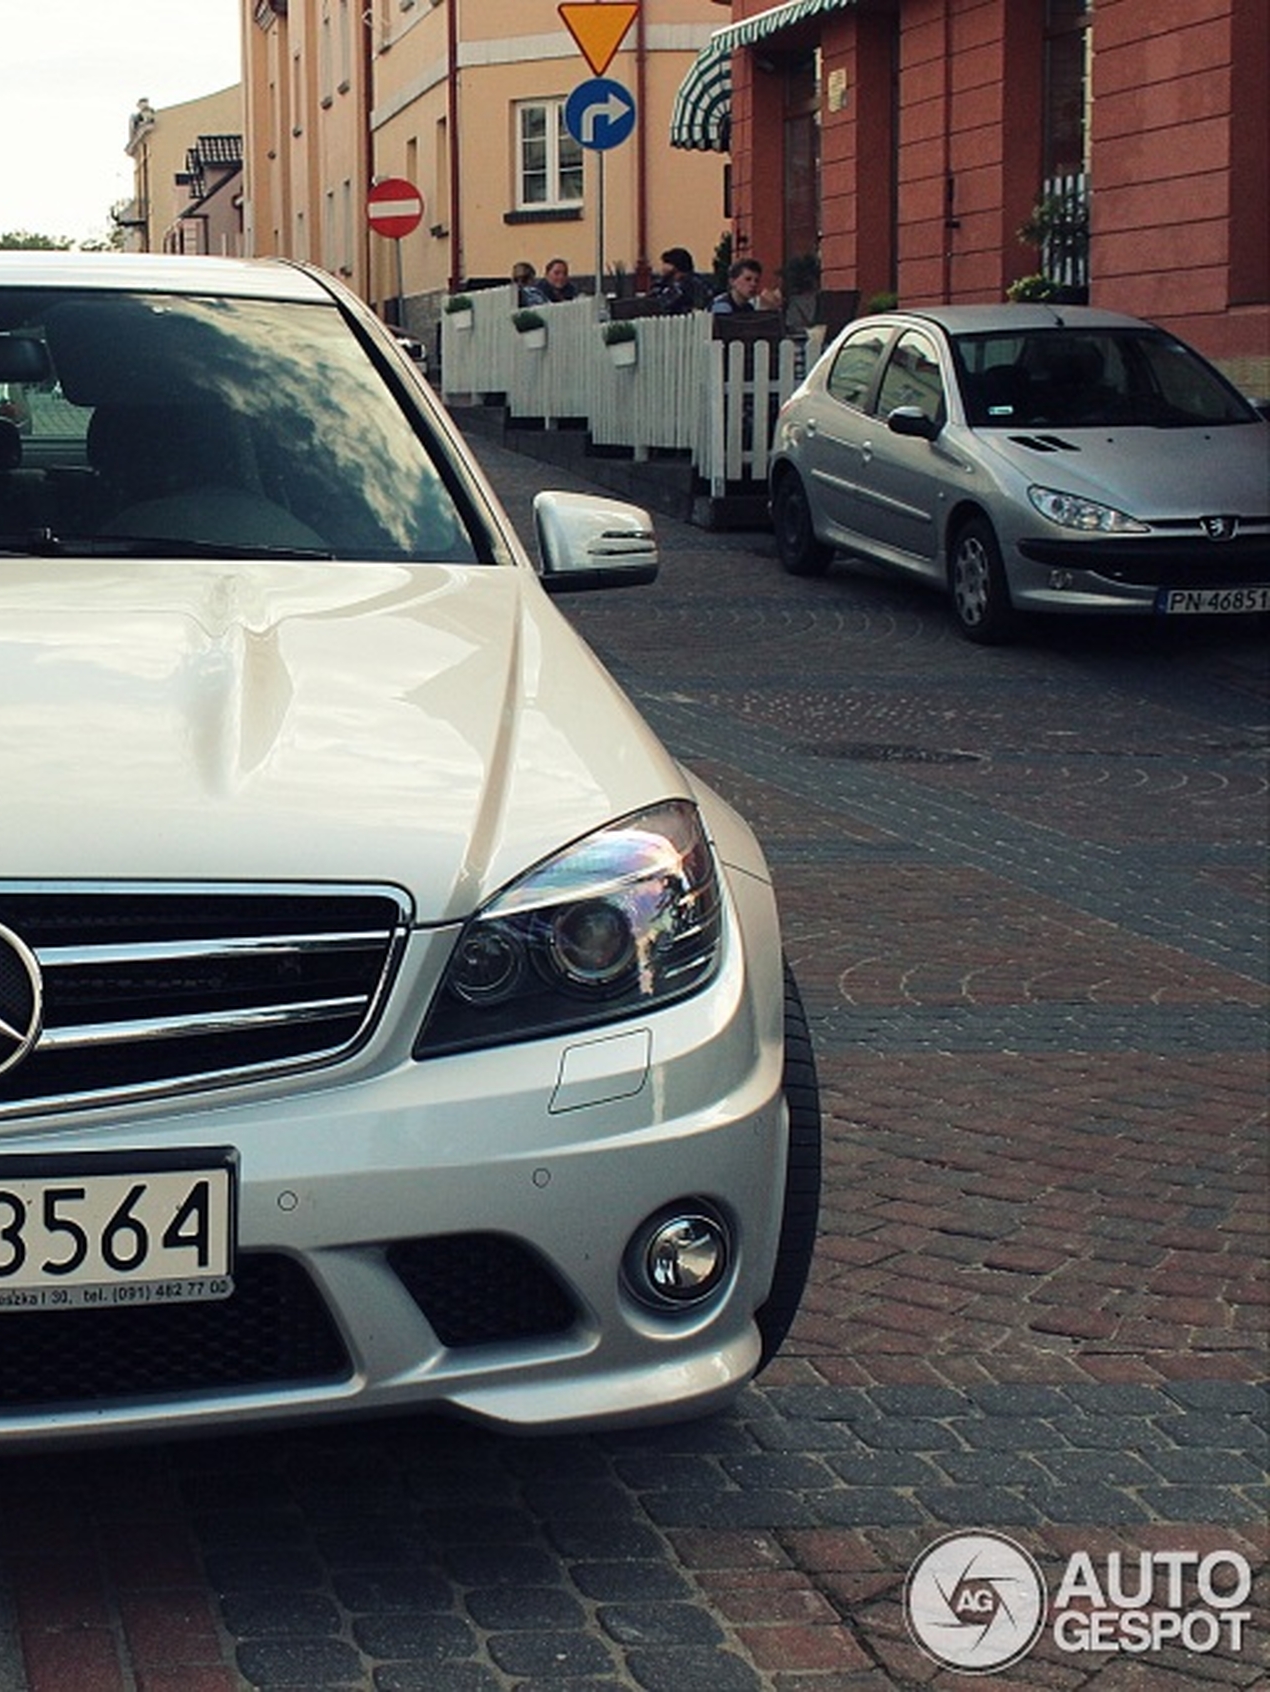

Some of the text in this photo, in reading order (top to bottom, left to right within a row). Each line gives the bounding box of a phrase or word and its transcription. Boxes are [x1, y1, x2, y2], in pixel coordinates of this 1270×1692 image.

[1170, 590, 1268, 611] PN 46851
[83, 1287, 108, 1303] tel.
[187, 1281, 204, 1295] 77
